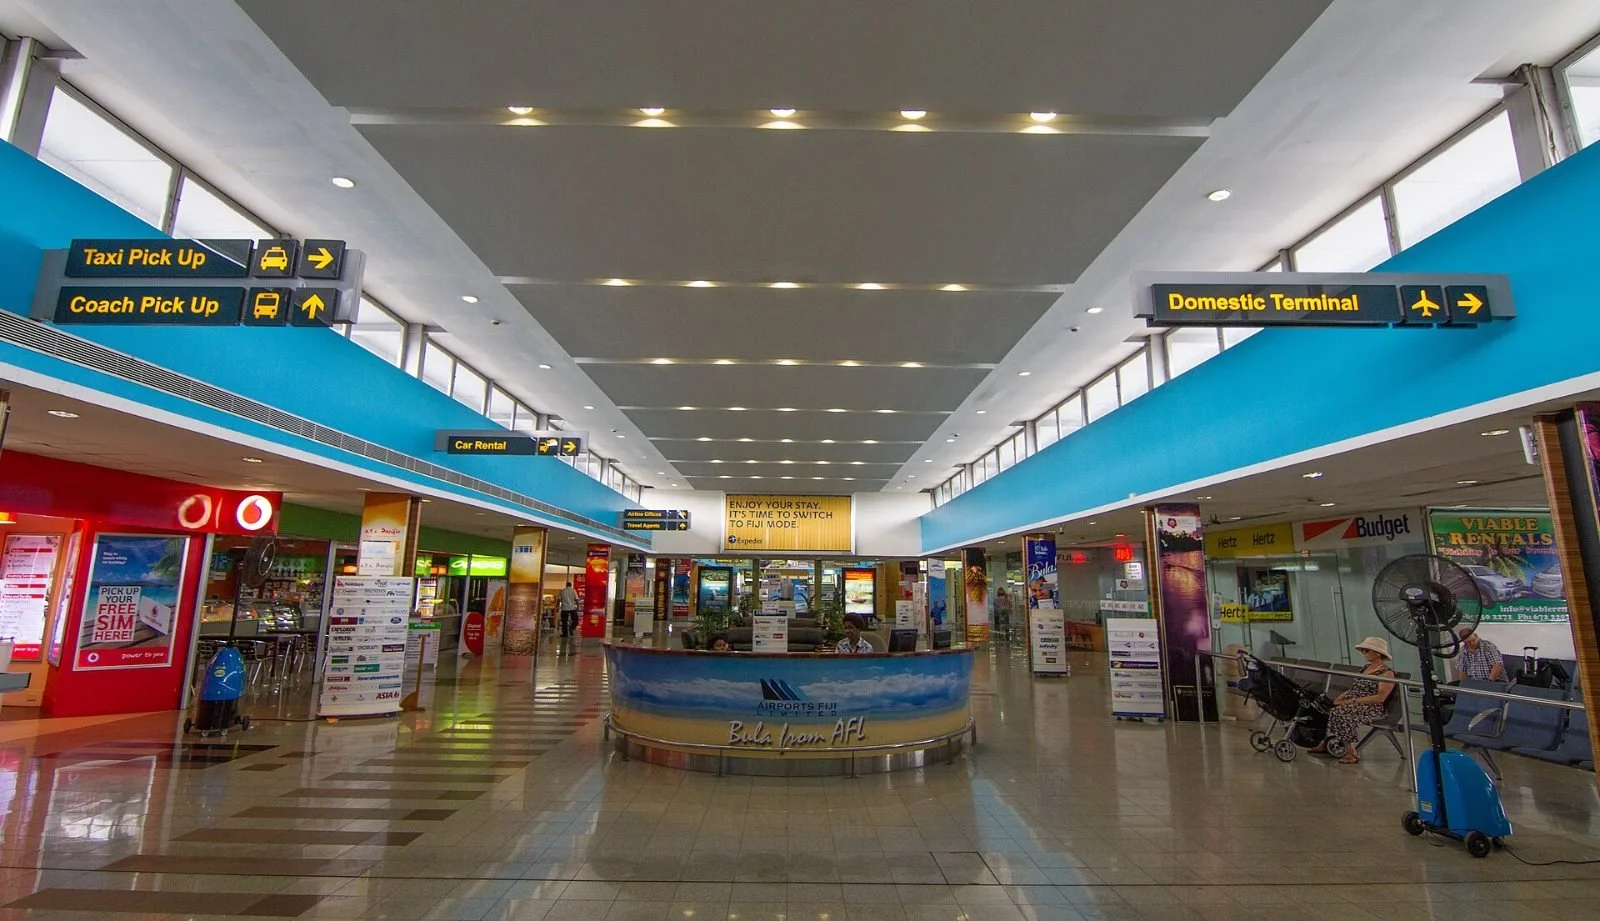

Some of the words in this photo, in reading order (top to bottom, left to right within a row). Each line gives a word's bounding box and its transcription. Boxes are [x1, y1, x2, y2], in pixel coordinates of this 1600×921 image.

[84, 248, 124, 266] Taxi
[128, 249, 174, 266] Pick
[177, 249, 206, 269] Up
[70, 296, 136, 314] Coach
[139, 296, 185, 314] Pick
[190, 297, 219, 317] Up
[1168, 293, 1266, 311] Domestic
[1270, 293, 1359, 311] Terminal
[455, 441, 473, 450] Car
[475, 441, 507, 450] Rental
[729, 501, 762, 509] ENJOY
[766, 501, 793, 509] YOUR
[729, 510, 746, 519] IT'S
[749, 510, 774, 519] TIME
[777, 511, 790, 519] TO
[793, 511, 833, 519] SWITCH
[730, 520, 743, 528] TO
[746, 520, 763, 528] FIJI
[767, 520, 799, 529] MODE.
[1356, 514, 1410, 541] Budget
[1461, 518, 1538, 531] VIABLE
[1218, 536, 1237, 549] Hertz
[1253, 533, 1275, 546] Hertz
[1450, 532, 1553, 545] RENTALS
[101, 587, 124, 595] PICK
[98, 604, 137, 614] FREE
[1220, 605, 1246, 619] Hertz
[97, 615, 134, 630] SIM
[94, 631, 133, 640] HERE!
[757, 702, 815, 711] AIRPORTS
[817, 702, 837, 710] FIJI
[729, 720, 773, 745] Bula
[779, 722, 825, 749] from
[832, 716, 866, 746] AFL
